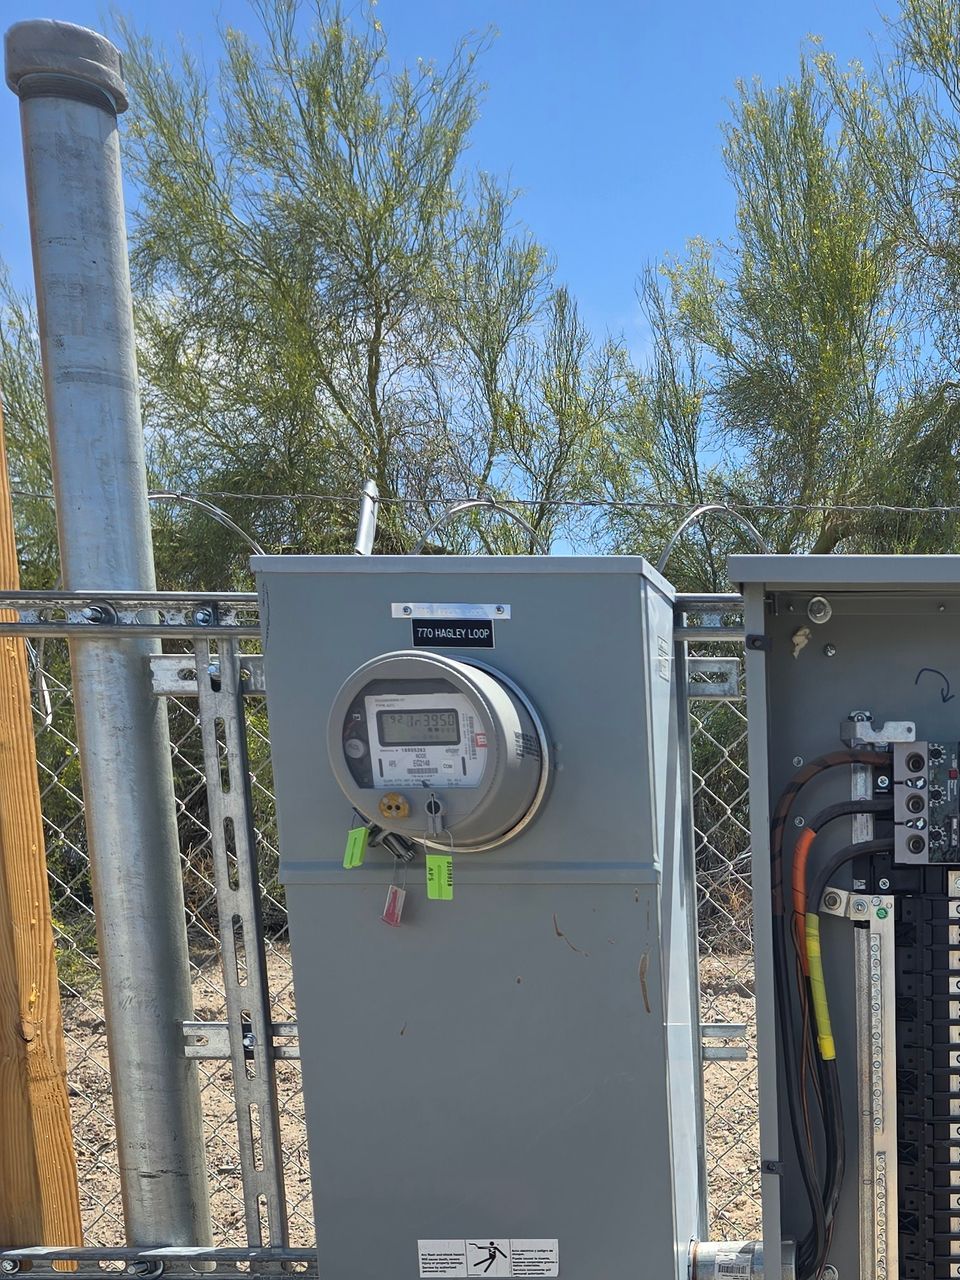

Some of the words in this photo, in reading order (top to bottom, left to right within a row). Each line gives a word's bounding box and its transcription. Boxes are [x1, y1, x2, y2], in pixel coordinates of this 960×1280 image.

[417, 628, 434, 638] 770
[435, 628, 466, 638] HAGLEY
[468, 629, 490, 638] LOOP
